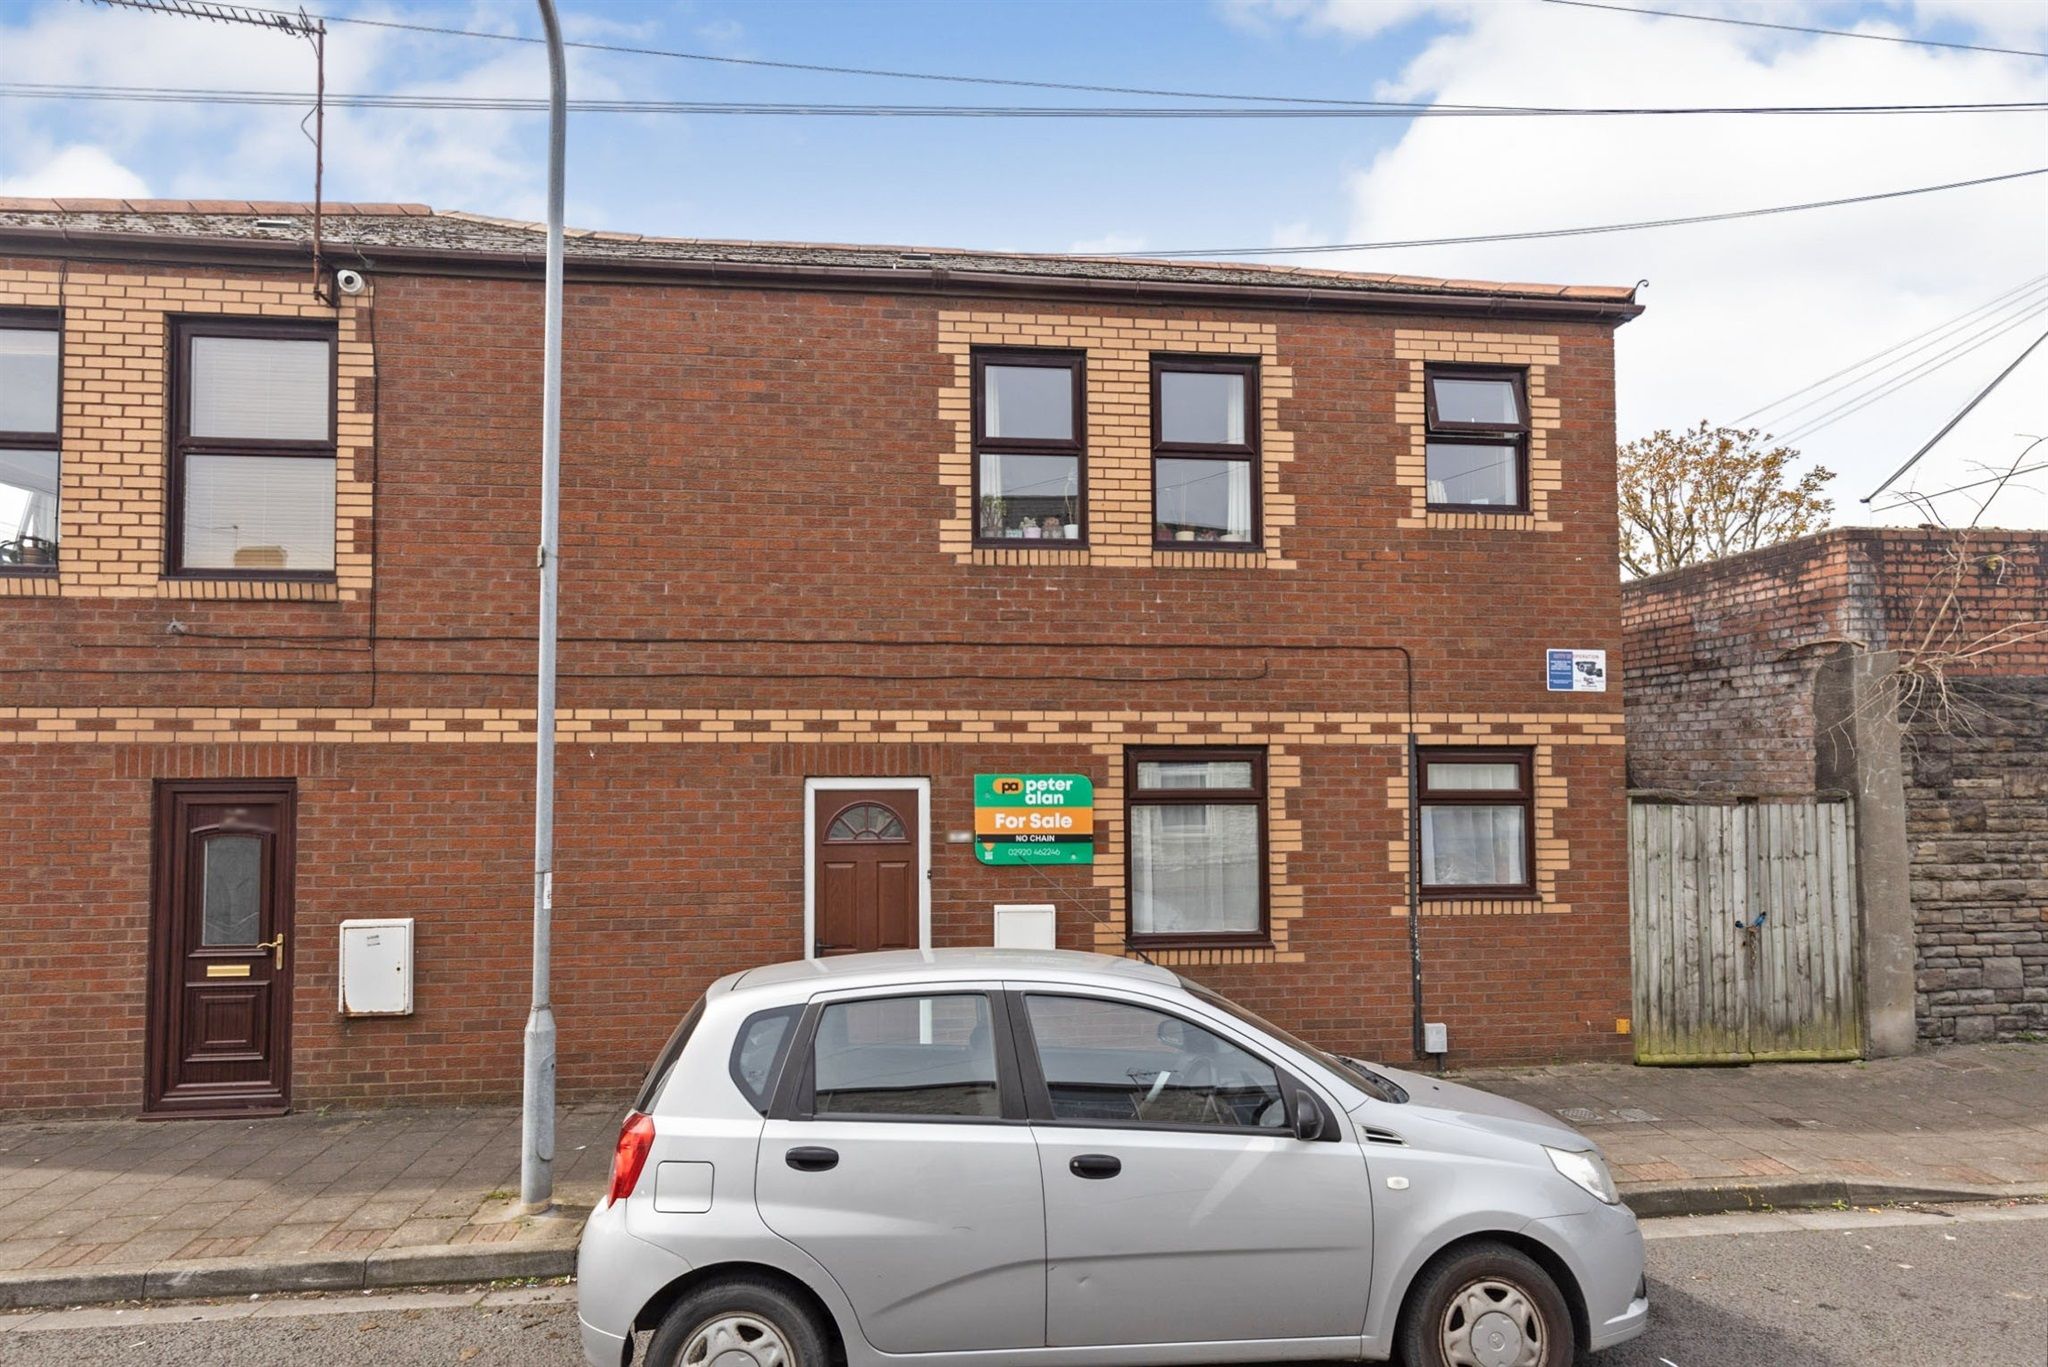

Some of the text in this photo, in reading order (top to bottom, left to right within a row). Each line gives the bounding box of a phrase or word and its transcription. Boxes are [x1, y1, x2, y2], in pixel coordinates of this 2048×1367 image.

[1001, 782, 1019, 794] pa
[1025, 778, 1074, 794] peter
[1025, 791, 1065, 805] alan
[994, 812, 1073, 829] For Sale
[1015, 834, 1056, 843] NO CHAIN
[1007, 847, 1061, 857] 02920 462246
